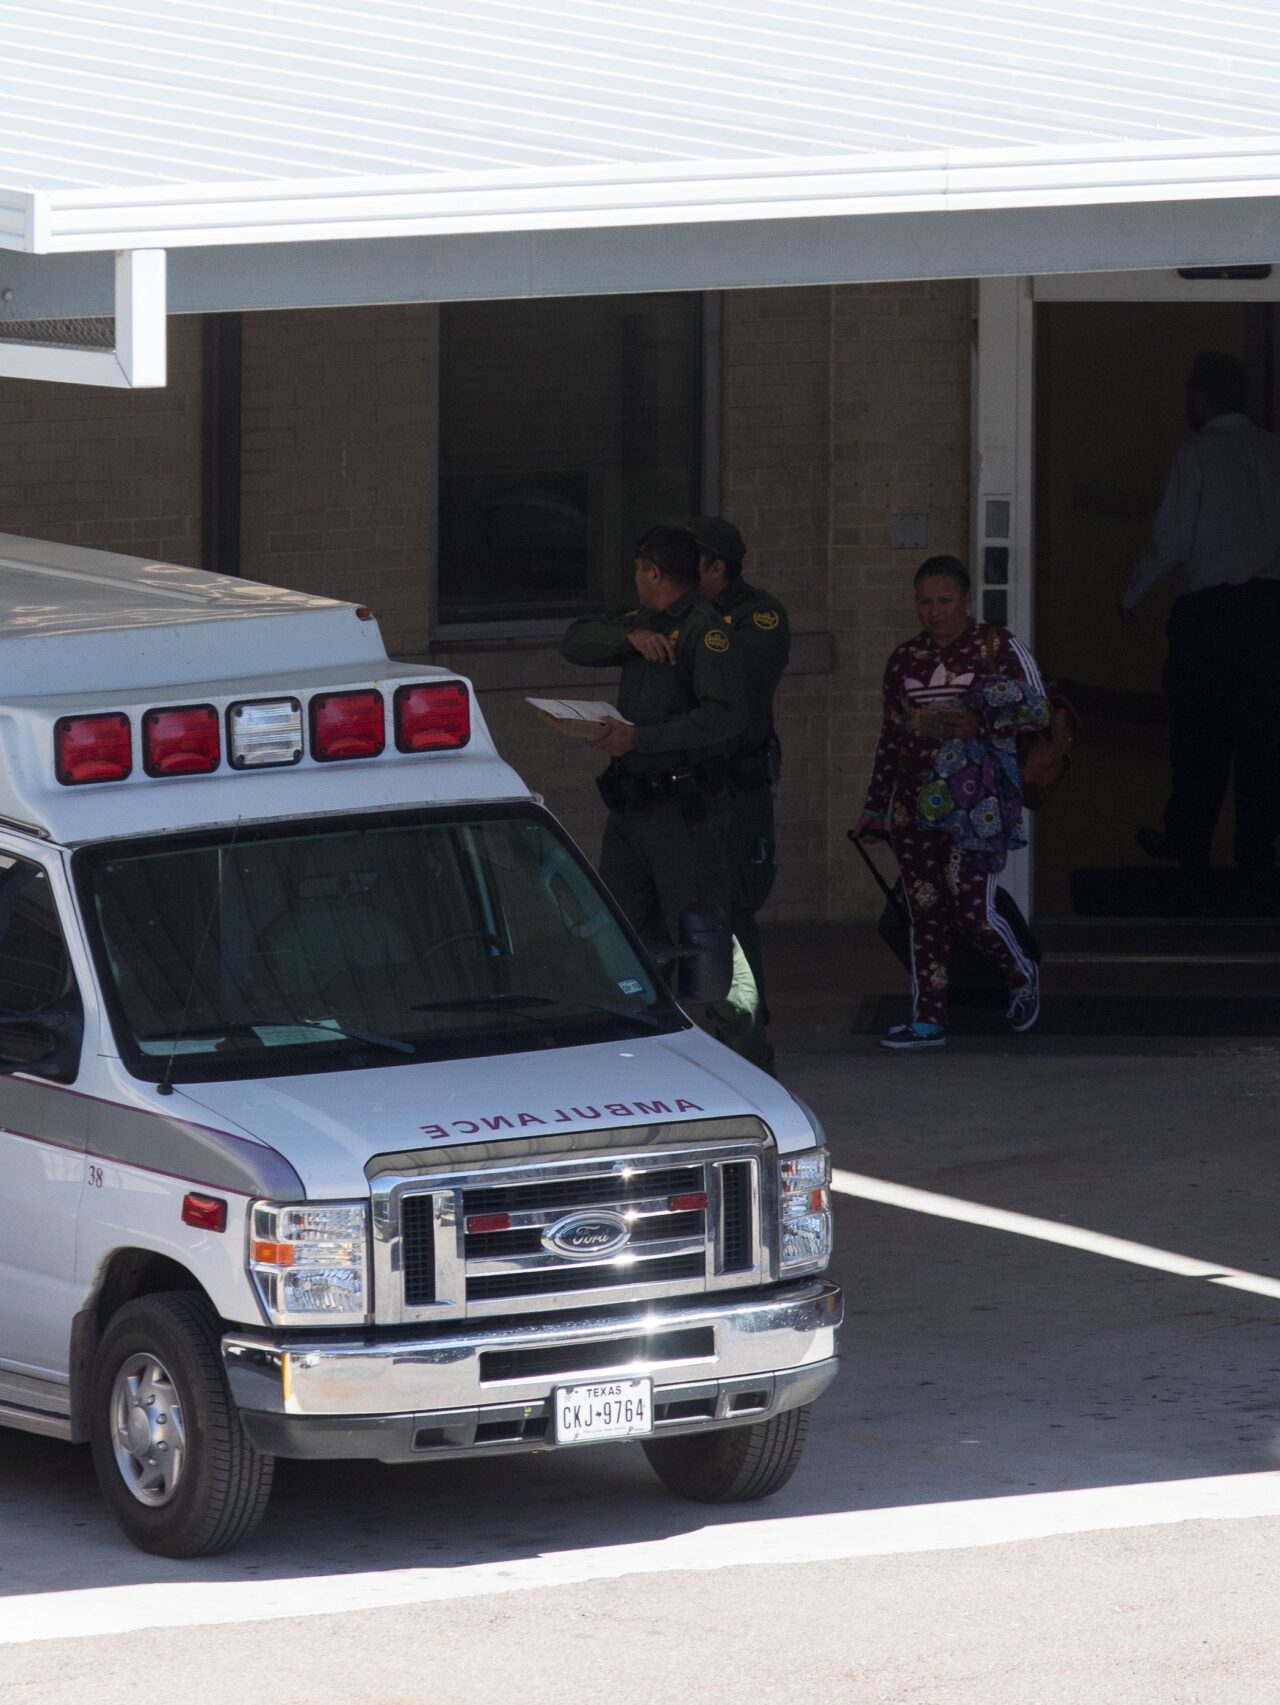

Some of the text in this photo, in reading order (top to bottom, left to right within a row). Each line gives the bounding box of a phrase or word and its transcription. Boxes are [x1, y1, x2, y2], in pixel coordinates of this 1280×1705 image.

[87, 1165, 104, 1188] 38
[573, 1225, 609, 1245] Ford
[586, 1385, 622, 1398] TEXAS
